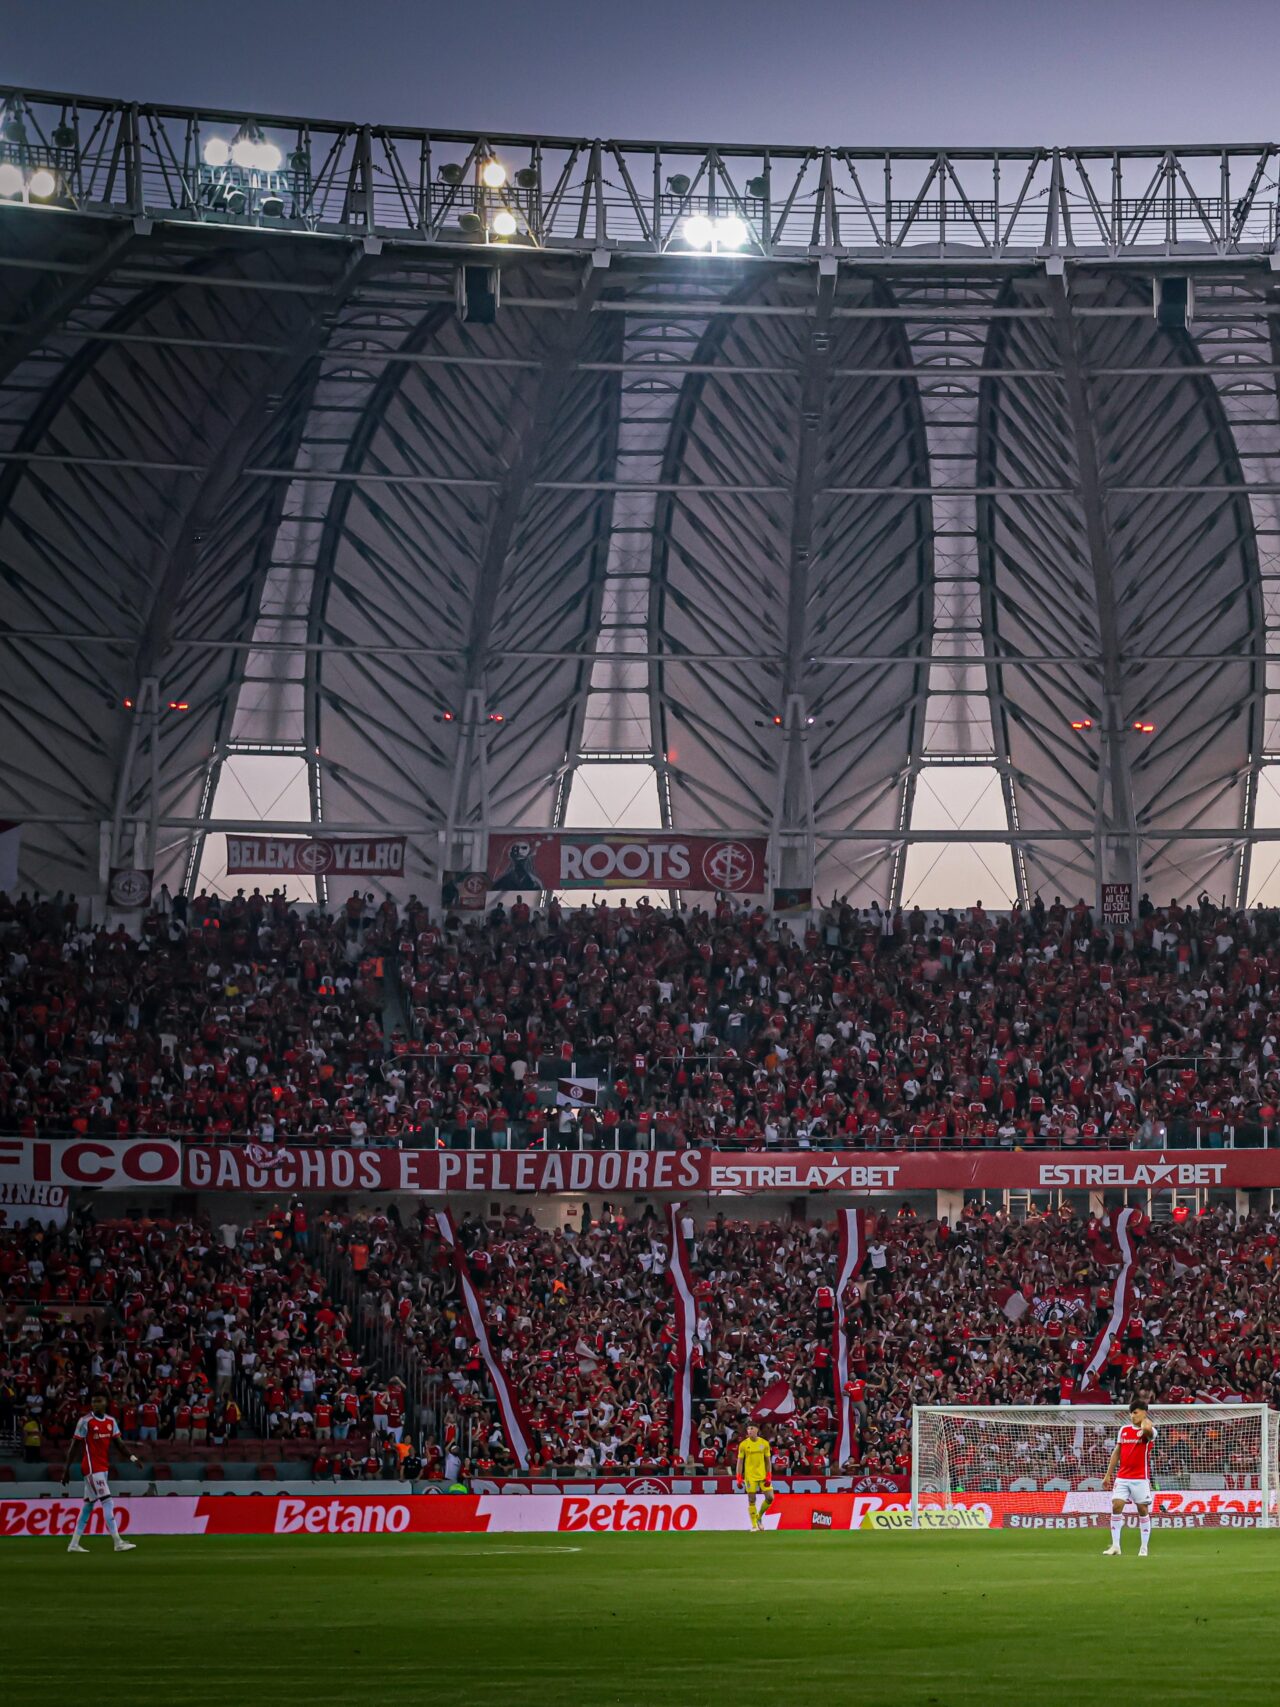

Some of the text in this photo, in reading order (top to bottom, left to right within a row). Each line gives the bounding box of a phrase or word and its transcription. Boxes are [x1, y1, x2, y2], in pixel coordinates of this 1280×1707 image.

[335, 840, 401, 870] VELHO
[559, 843, 691, 880] ROOTS
[399, 1152, 420, 1190] E
[437, 1149, 703, 1190] PELEADORES
[711, 1166, 899, 1187] ESTRELA BET
[1039, 1164, 1227, 1185] ESTRELA BET
[0, 1502, 130, 1535] Betano
[274, 1500, 411, 1534] Betano
[557, 1498, 698, 1532] Betano
[812, 1511, 832, 1526] Betano
[875, 1510, 985, 1529] quartzolit
[1010, 1514, 1100, 1529] SUPERBET
[1115, 1513, 1206, 1529] UERBET
